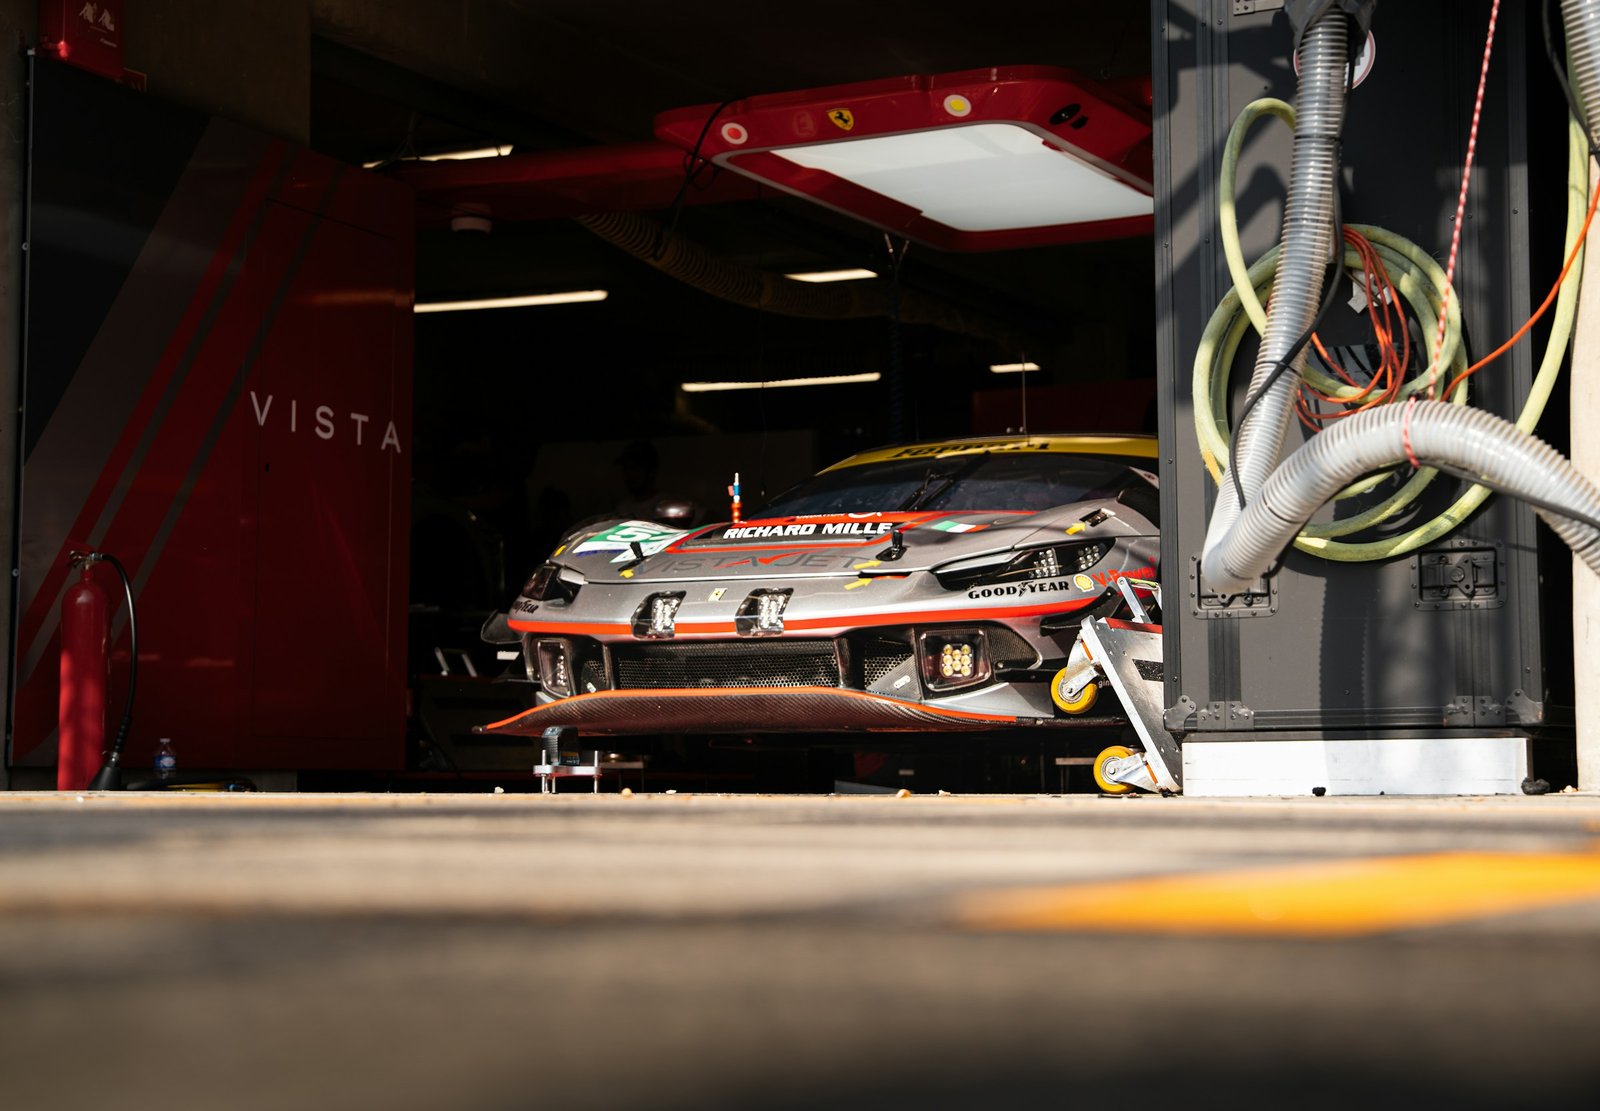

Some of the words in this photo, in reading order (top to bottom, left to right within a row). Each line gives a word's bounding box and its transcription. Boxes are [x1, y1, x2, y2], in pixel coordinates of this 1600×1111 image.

[250, 390, 402, 454] VISTA
[723, 524, 818, 539] RICHARD
[821, 523, 893, 535] MILLE
